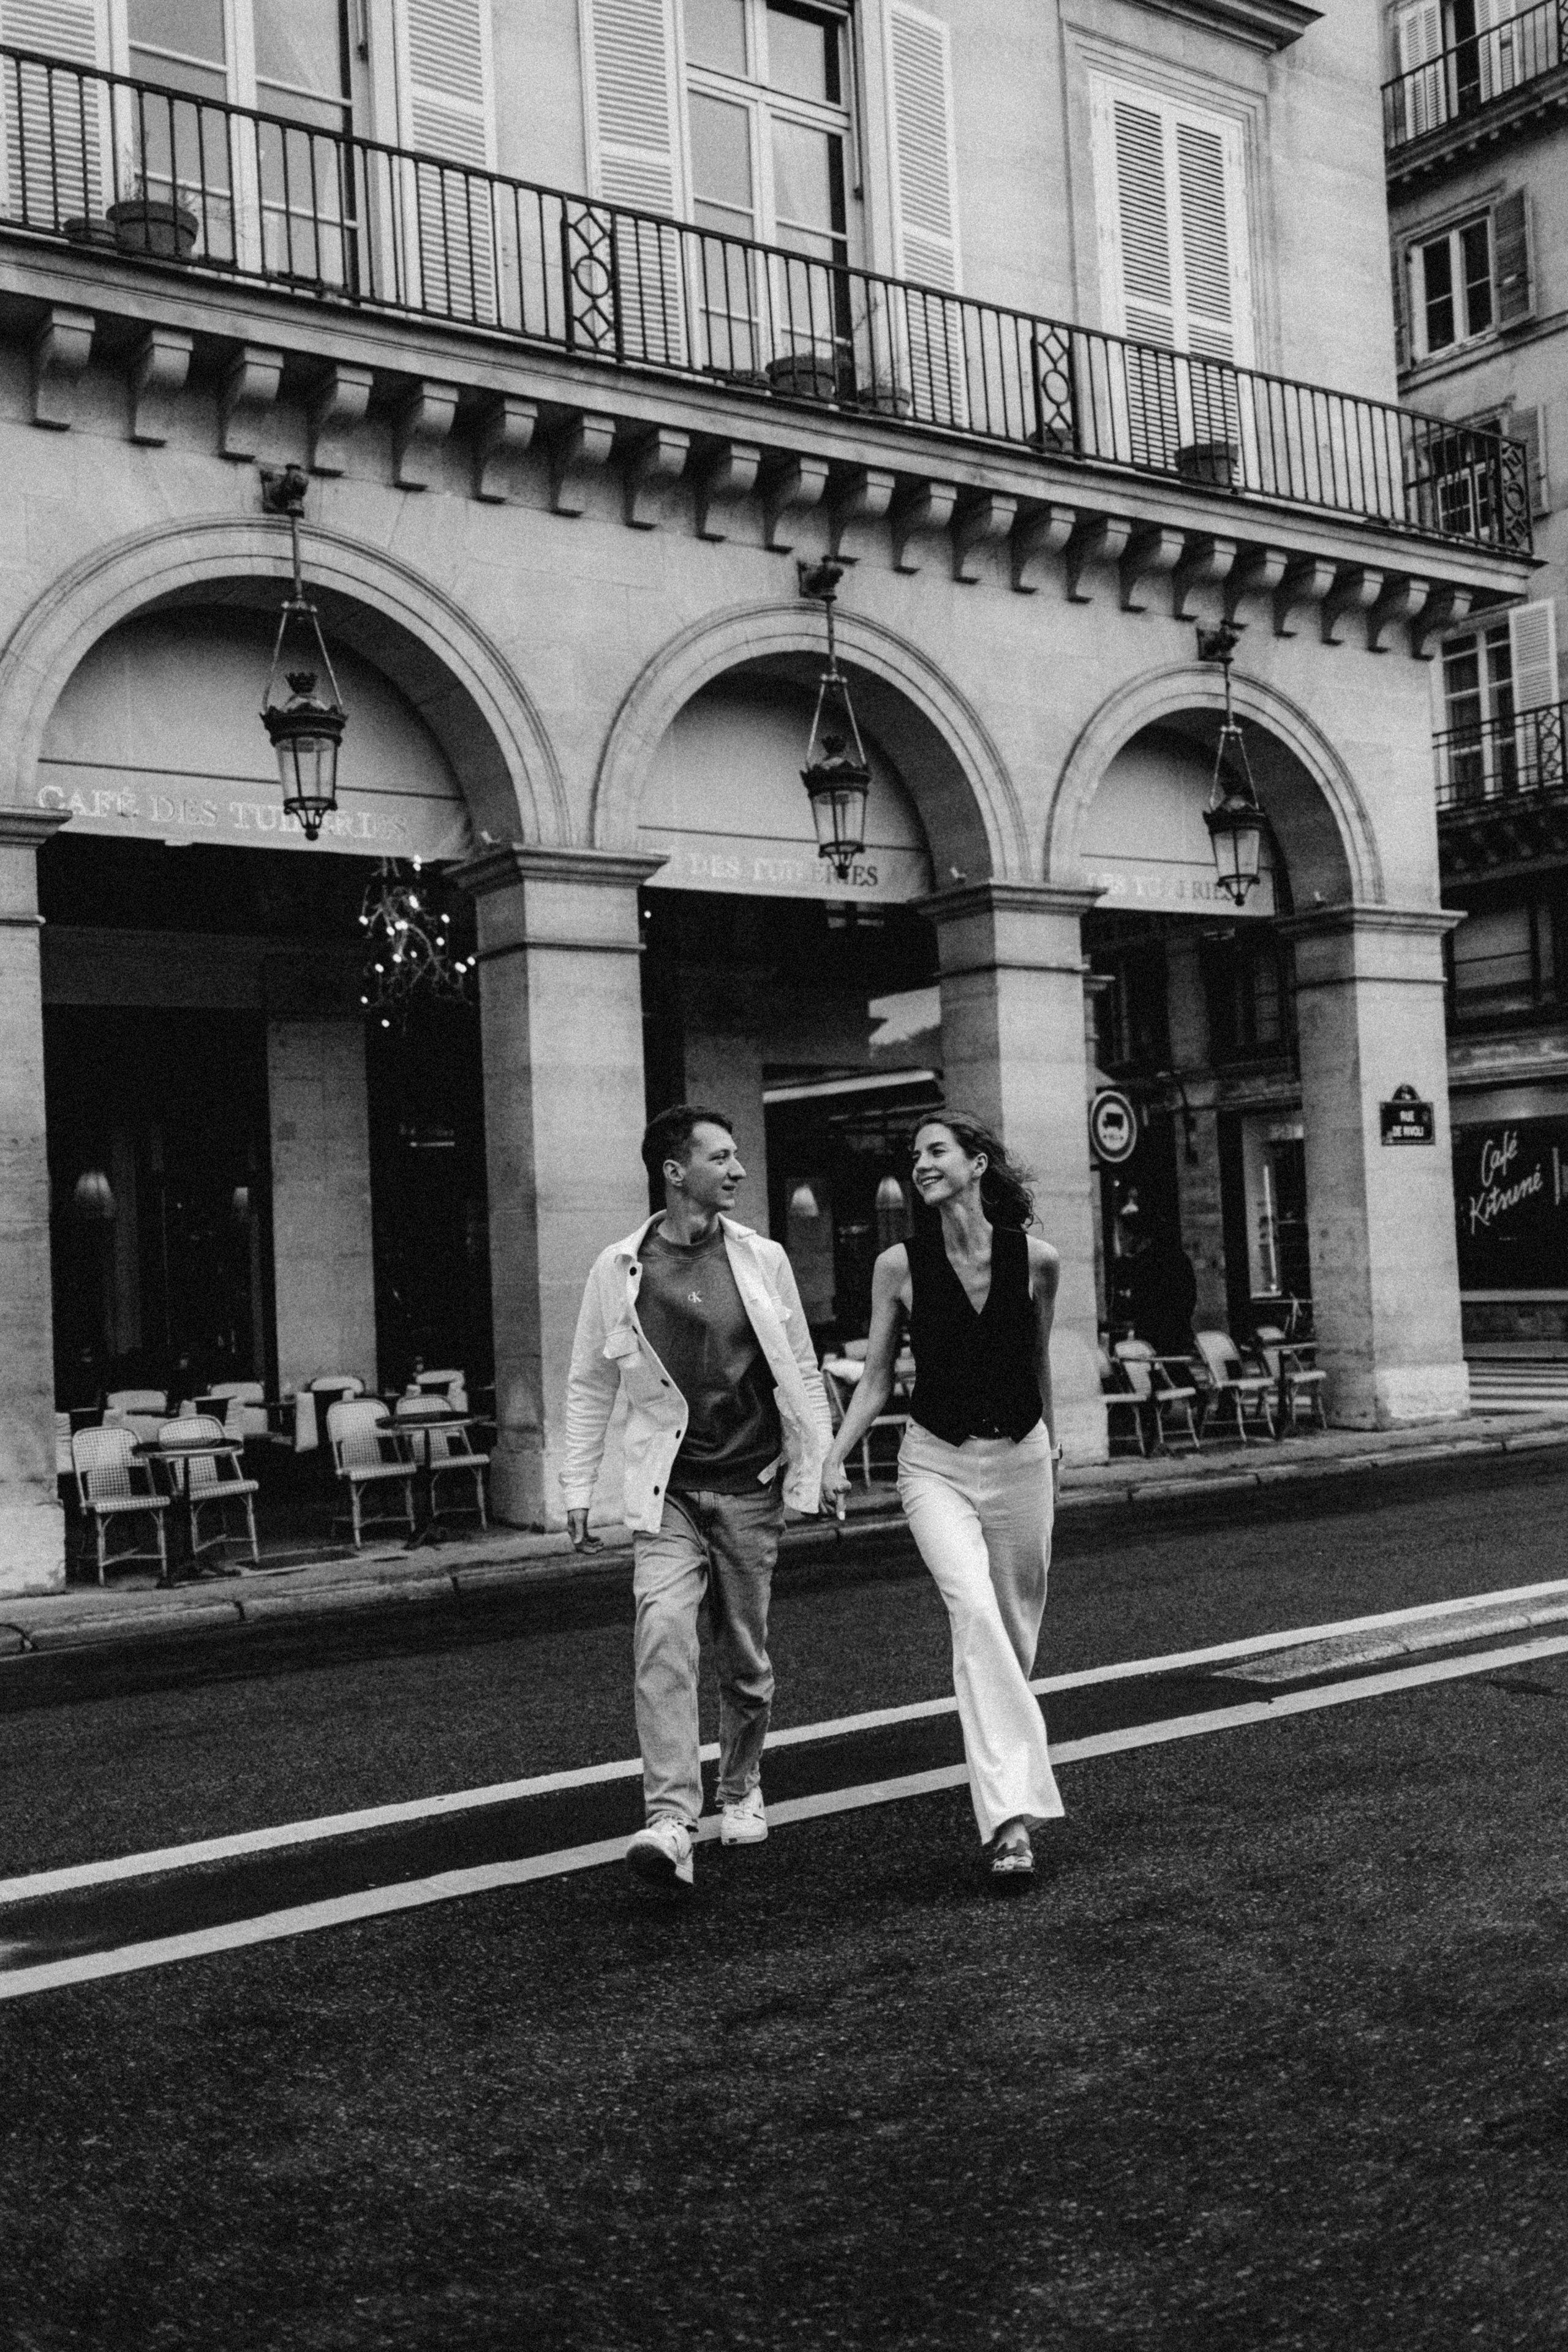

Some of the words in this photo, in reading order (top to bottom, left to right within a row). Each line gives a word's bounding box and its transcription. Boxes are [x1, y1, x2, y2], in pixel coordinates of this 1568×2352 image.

[37, 785, 138, 818] CAFÉ
[150, 794, 218, 827] DES
[1400, 1110, 1415, 1122] RUE
[1392, 1125, 1402, 1137] DE
[1403, 1125, 1425, 1137] RIVOLI
[1481, 1131, 1518, 1187] Café
